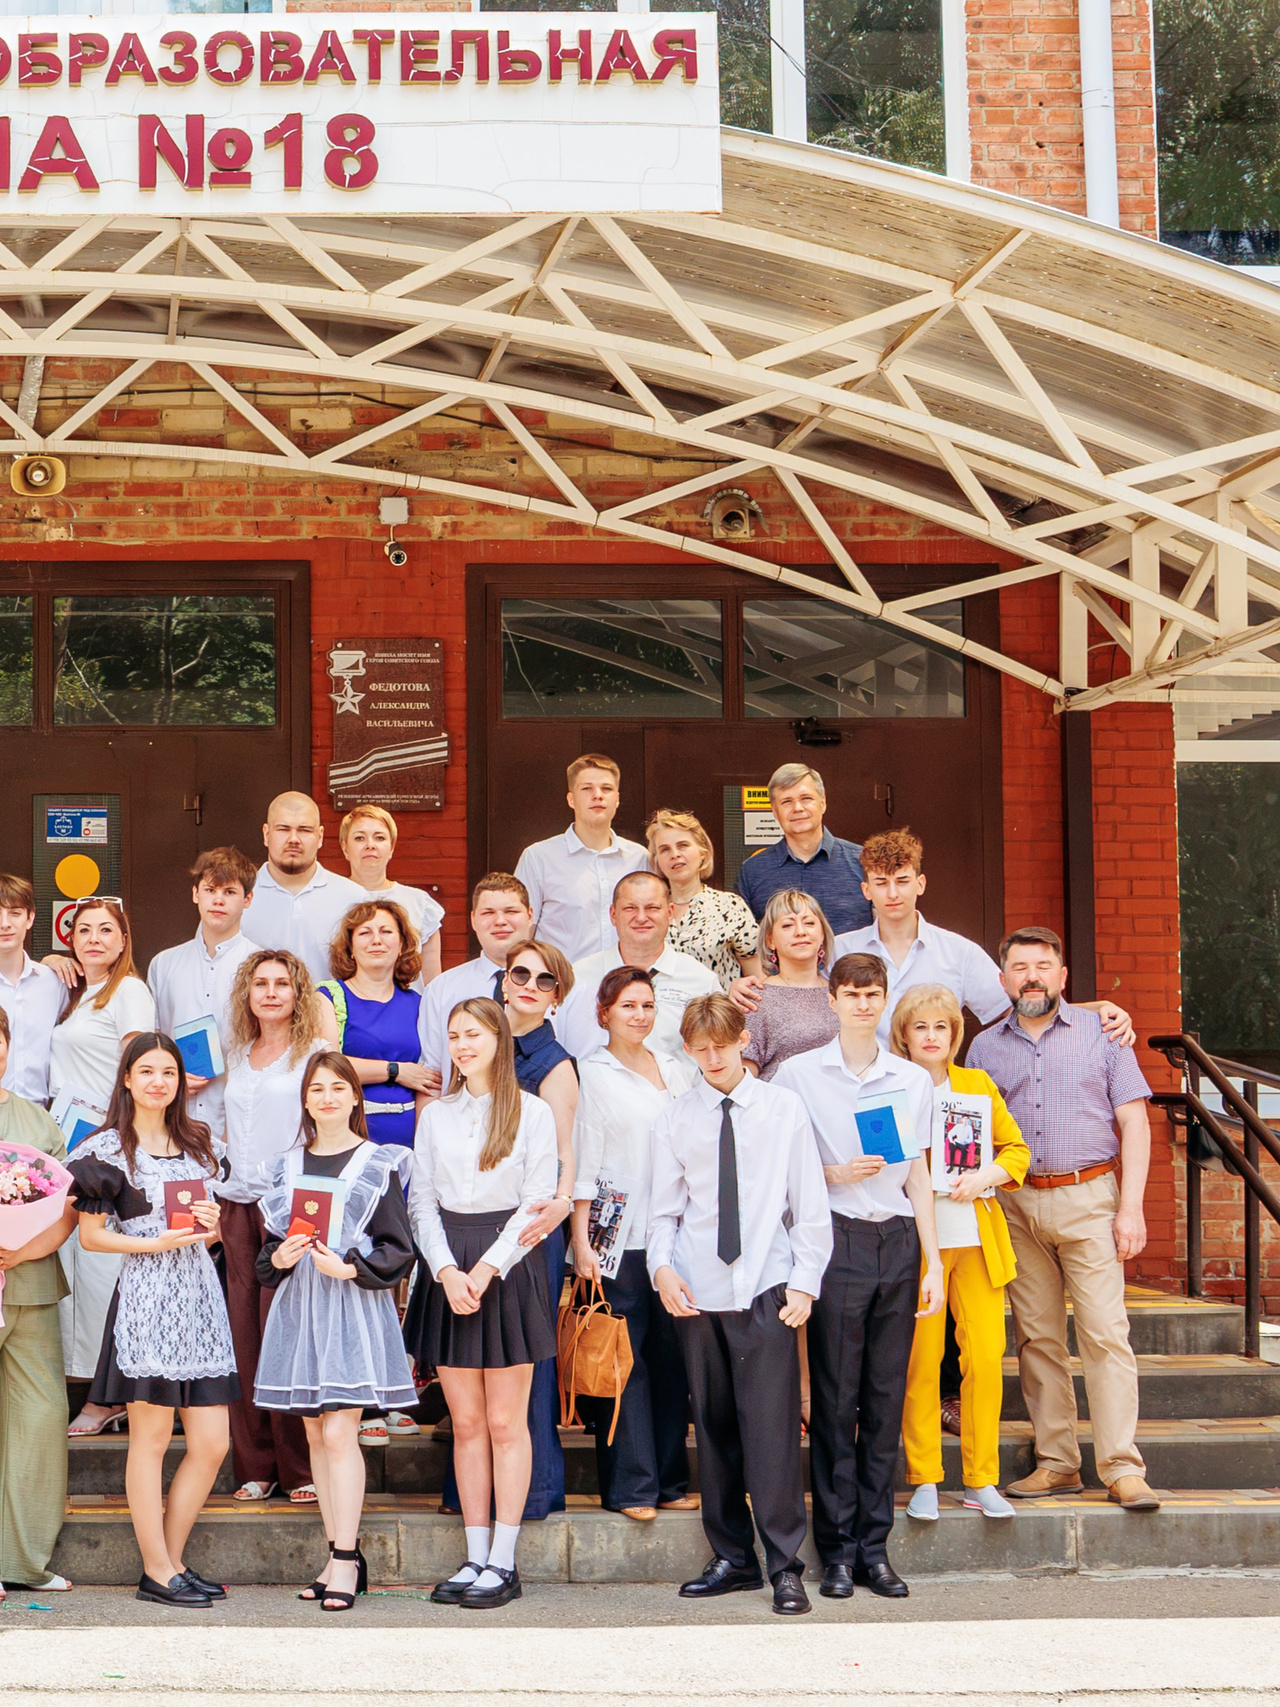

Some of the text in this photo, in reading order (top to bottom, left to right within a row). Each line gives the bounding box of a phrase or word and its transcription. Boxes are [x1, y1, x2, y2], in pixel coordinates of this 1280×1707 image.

[138, 112, 379, 193] №18
[370, 683, 430, 692] ФЕДОТОВА
[370, 702, 430, 710] АЛЕКСАНДРА
[366, 720, 434, 728] ВАСИЛЬЕВИЧА
[747, 790, 769, 798] ВНИМ
